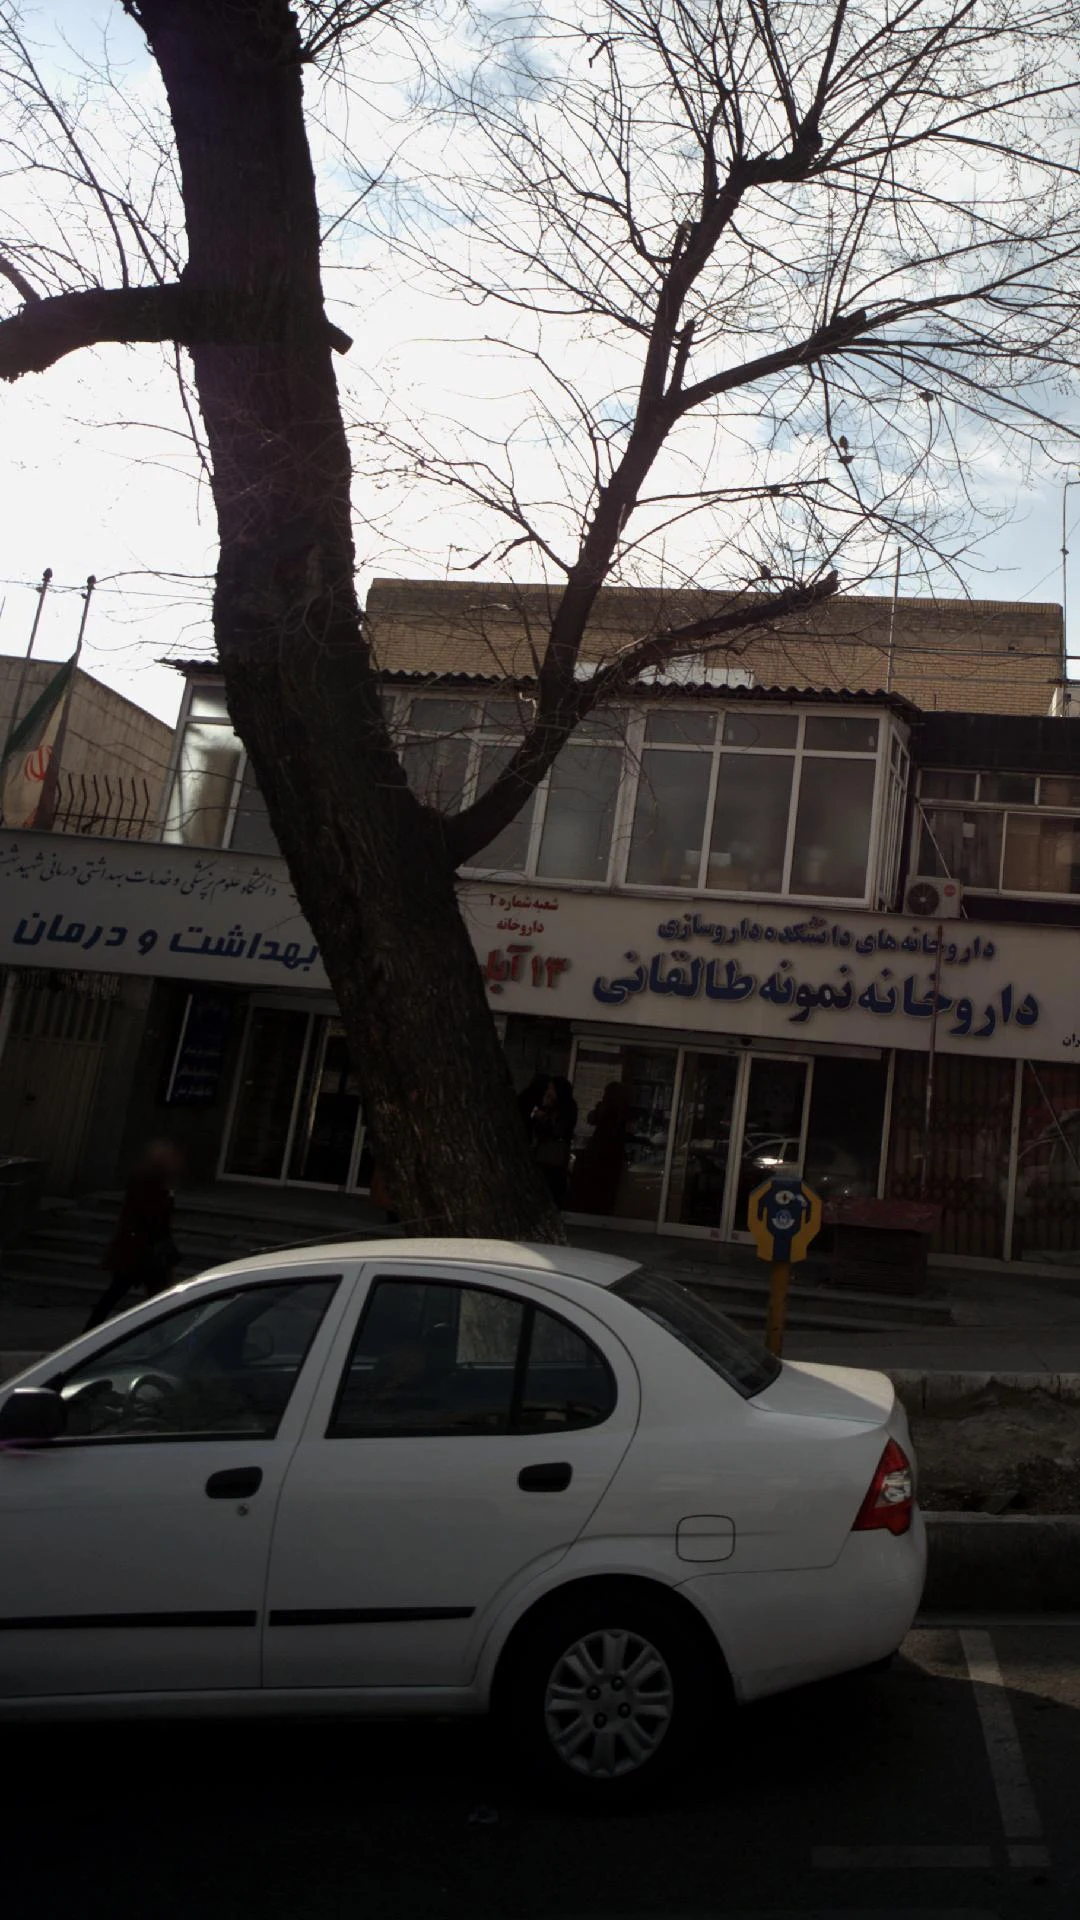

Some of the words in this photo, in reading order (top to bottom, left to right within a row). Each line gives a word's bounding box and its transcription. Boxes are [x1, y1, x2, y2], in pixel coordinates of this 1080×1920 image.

[12, 912, 129, 950] درمان
[137, 928, 158, 956] و
[496, 918, 545, 937] داروخانه
[657, 912, 763, 945] داروسازی
[764, 915, 854, 948] دانشکده
[855, 927, 899, 955] های
[901, 924, 996, 965] داروخانه
[169, 924, 321, 972] بهداشت
[481, 944, 532, 995] آبا
[591, 949, 757, 1006] طالقانی
[759, 959, 853, 1023] نمونه
[857, 966, 1040, 1037] داروخانه
